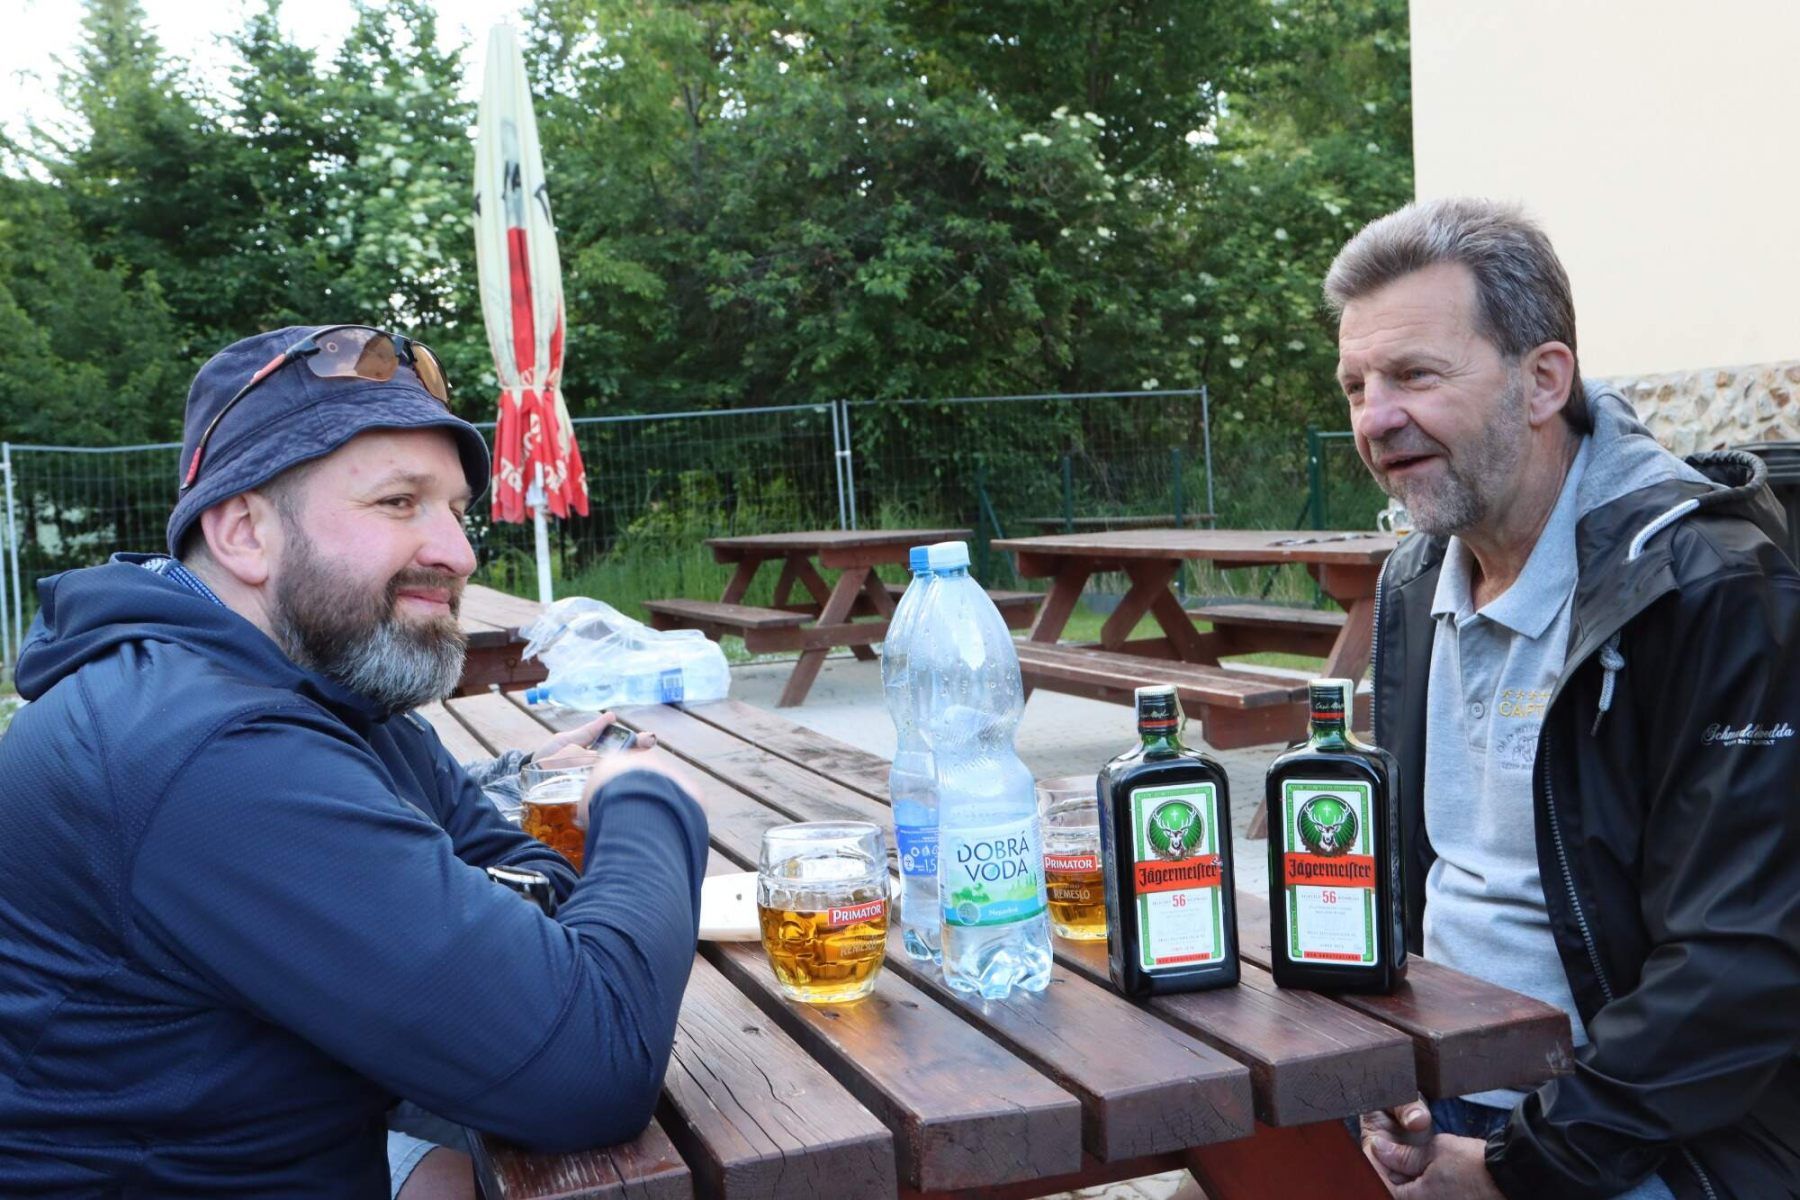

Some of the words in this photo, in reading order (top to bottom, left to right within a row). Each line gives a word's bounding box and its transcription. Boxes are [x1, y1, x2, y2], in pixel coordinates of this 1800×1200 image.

[957, 830, 1029, 863] DOBRÁ
[964, 858, 1028, 882] VODA
[1044, 856, 1093, 869] PRIMATOR
[1289, 858, 1371, 880] Jägermeister
[1138, 863, 1217, 887] Jägermeister
[1172, 893, 1187, 908] 56
[1322, 890, 1337, 904] 56
[832, 903, 883, 923] PRIMATOR
